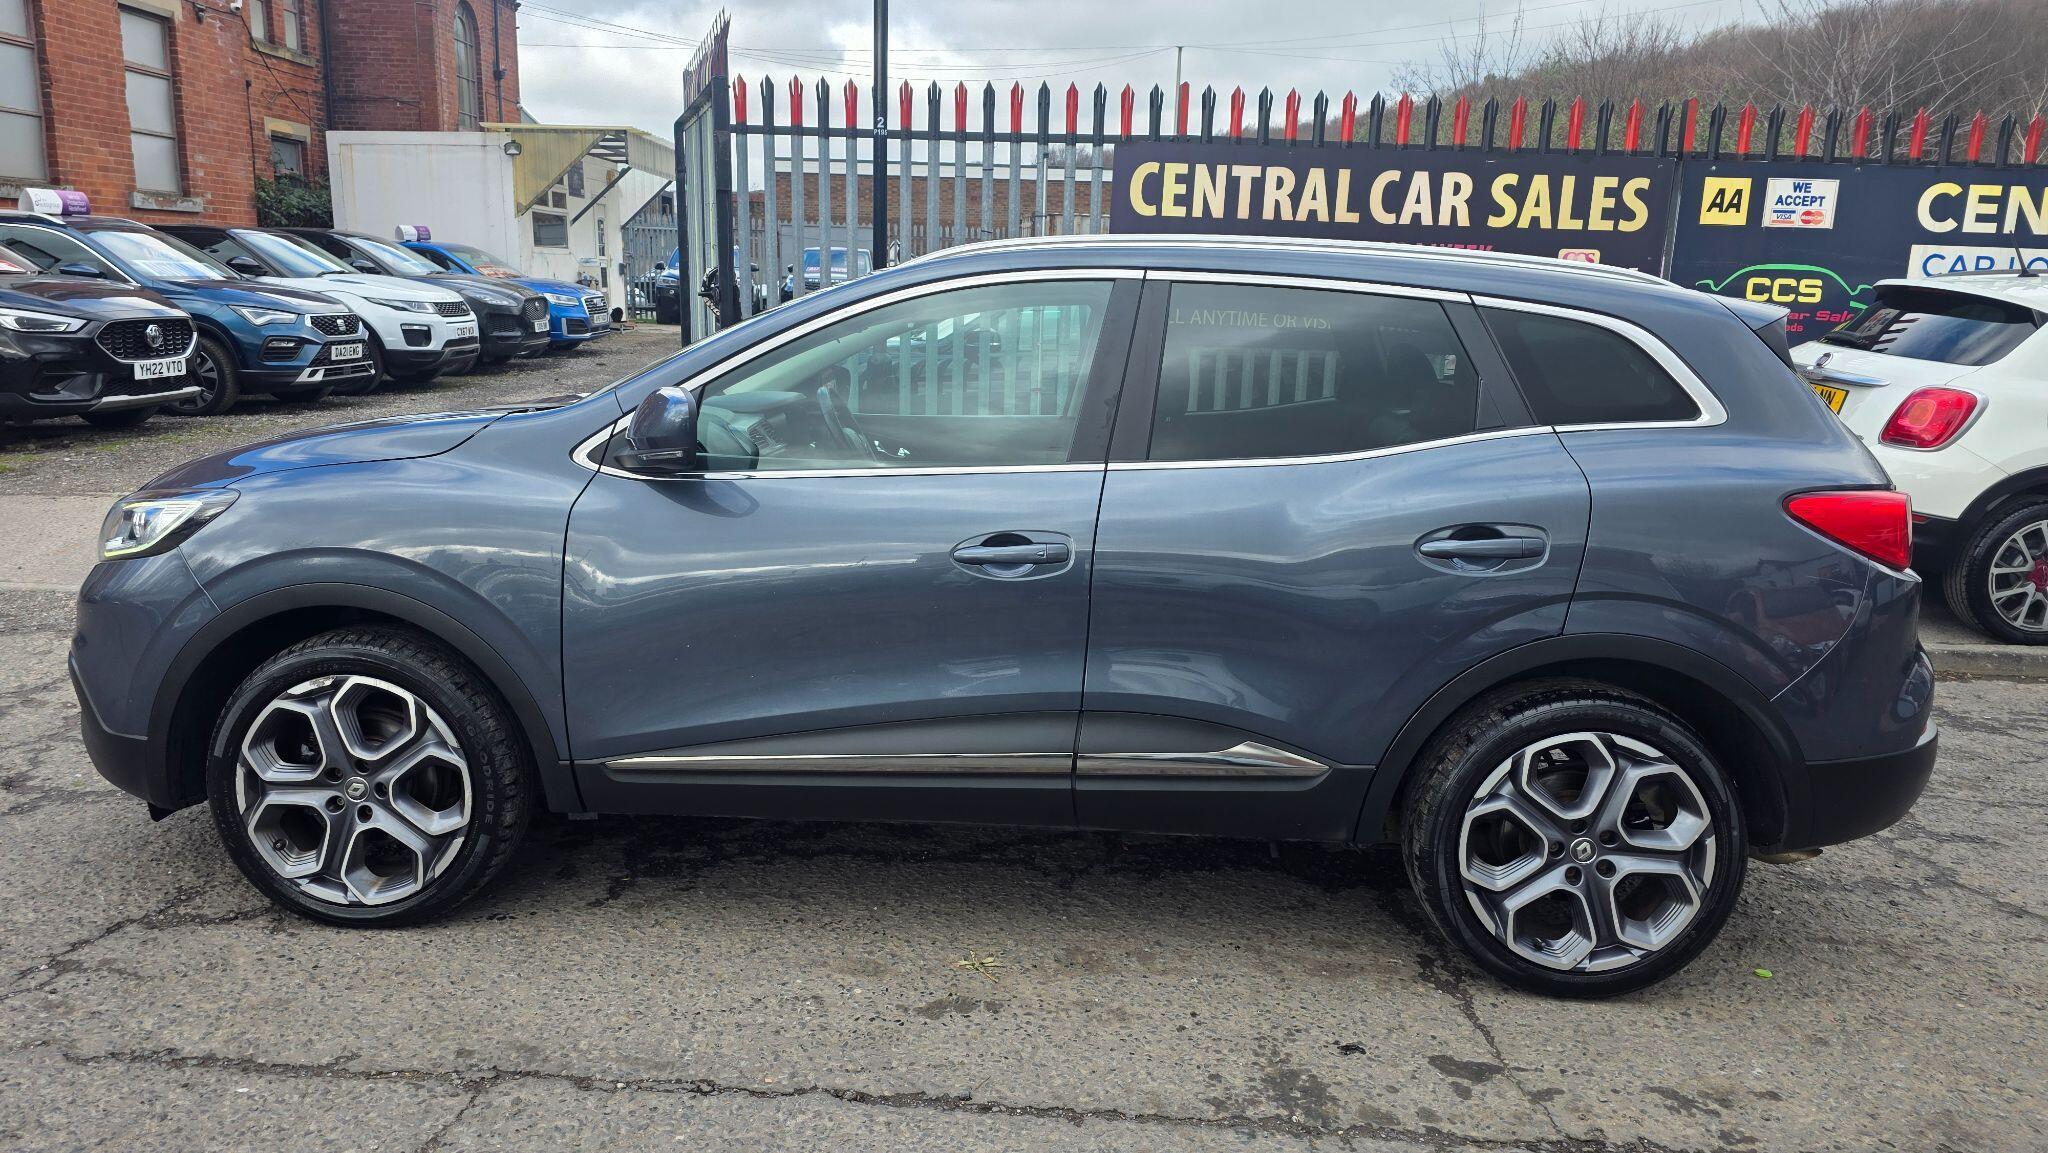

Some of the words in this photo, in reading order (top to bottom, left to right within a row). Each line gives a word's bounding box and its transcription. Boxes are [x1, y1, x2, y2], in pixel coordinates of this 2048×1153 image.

[876, 116, 885, 128] 2
[1793, 182, 1812, 193] WE
[1129, 161, 1360, 224] CENTRAL
[1369, 170, 1474, 227] CAR
[1486, 173, 1651, 233] SALES
[1706, 187, 1744, 213] AA
[1775, 195, 1826, 207] ACCEPT
[1746, 277, 1823, 304] CCS
[1190, 309, 1269, 328] ANYTIME
[1273, 313, 1297, 329] OR
[1788, 312, 1811, 321] ar
[139, 362, 164, 377] YH22
[165, 360, 183, 374] VTO
